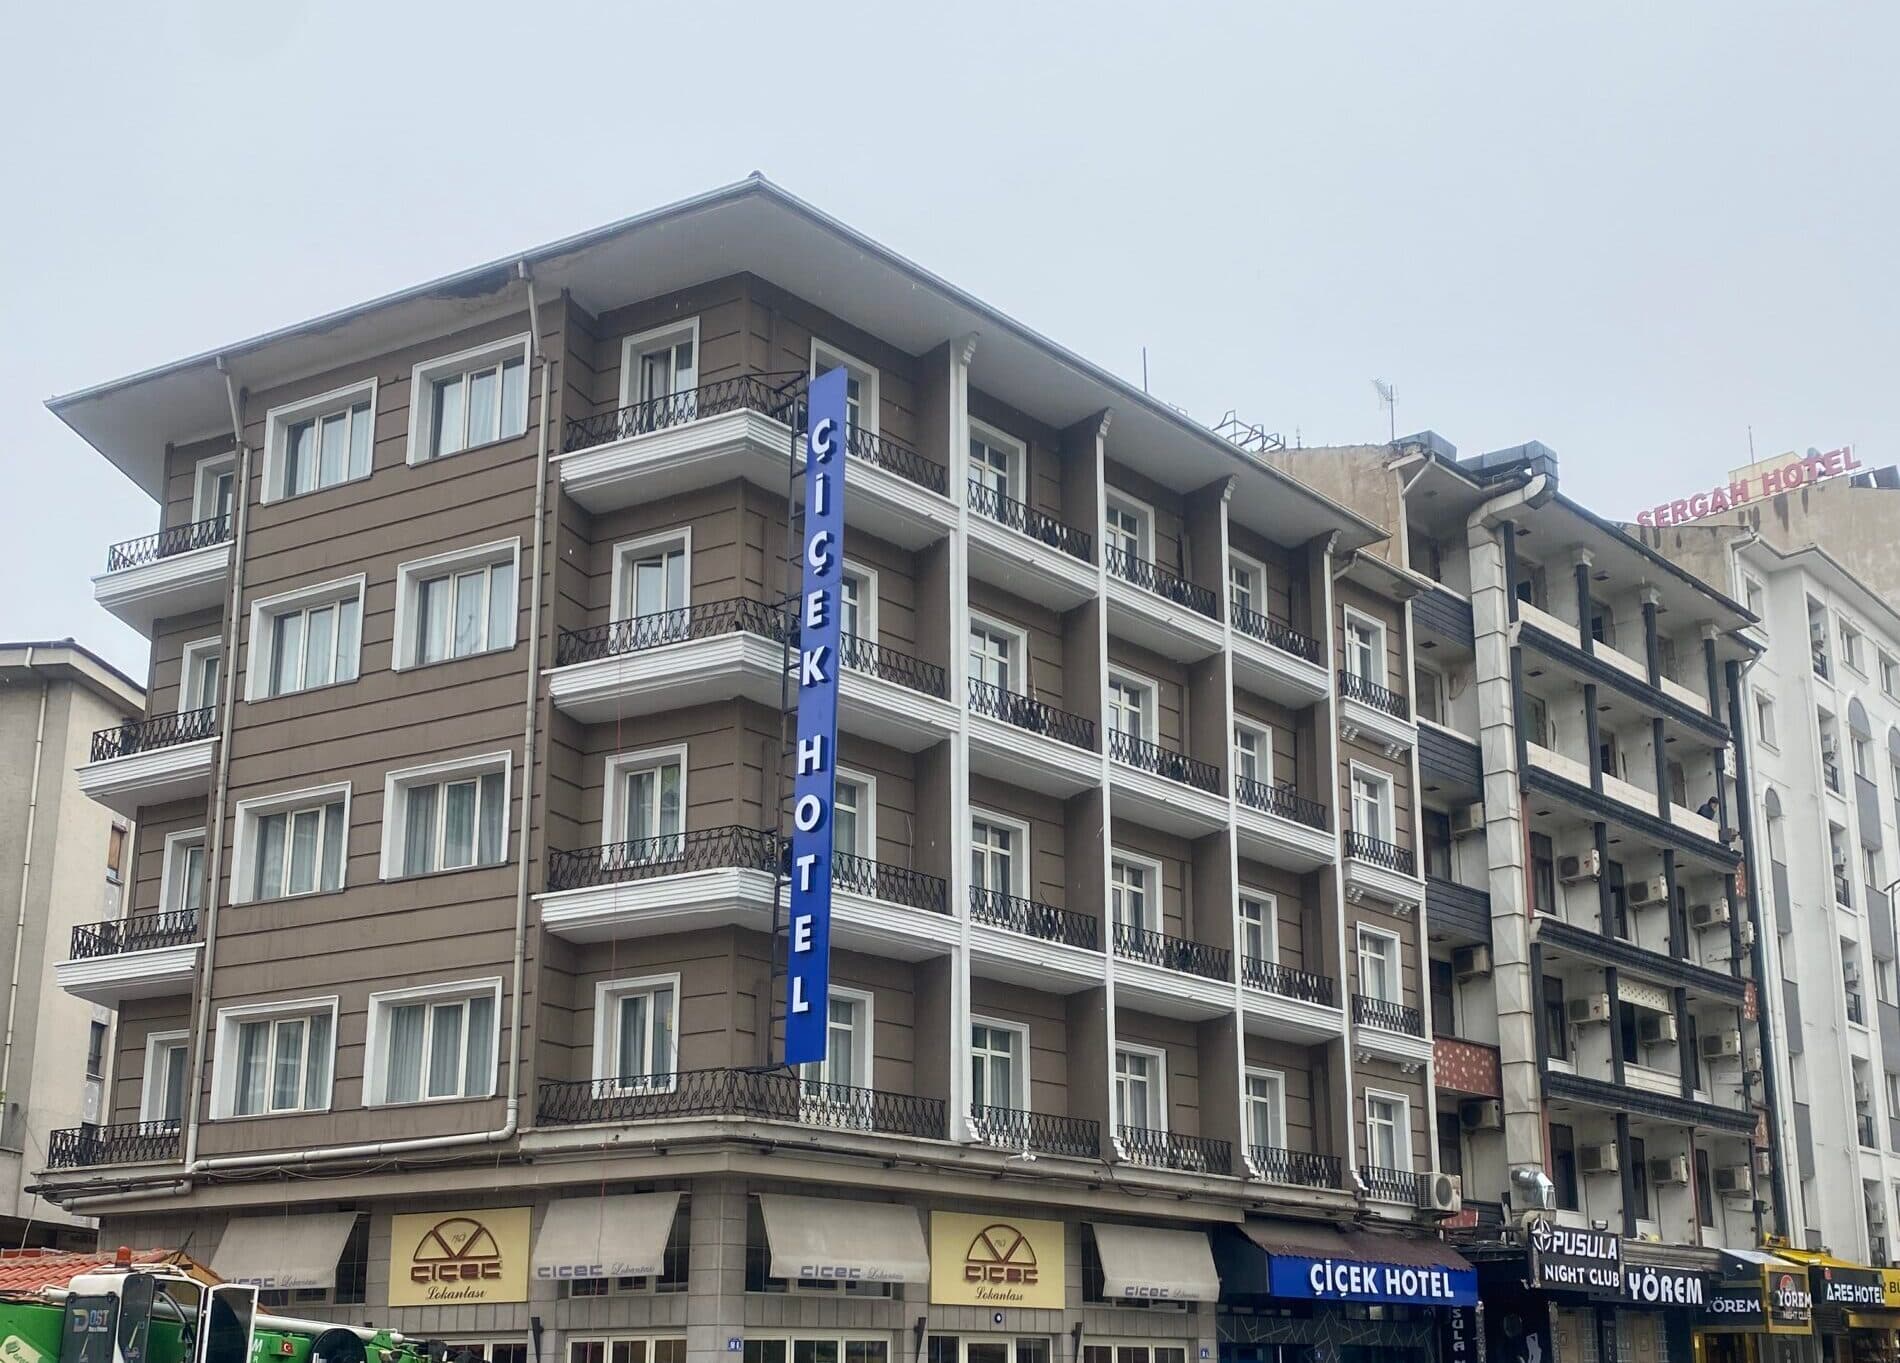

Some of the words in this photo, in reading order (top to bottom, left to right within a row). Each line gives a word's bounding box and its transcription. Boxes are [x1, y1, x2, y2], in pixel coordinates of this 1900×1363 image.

[1637, 479, 1750, 528] SERGAH
[1762, 446, 1862, 496] HOTEL
[802, 417, 837, 687] ÇİÇEK
[791, 734, 826, 1014] HOTEL
[1552, 1231, 1618, 1260] PUSULA
[427, 1285, 487, 1300] Lokantası
[1310, 1259, 1379, 1297] ÇİÇEK
[1385, 1268, 1455, 1298] HOTEL
[1544, 1264, 1585, 1284] NIGHT
[1589, 1268, 1620, 1288] CLUB
[1628, 1267, 1703, 1304] YÖREM
[975, 1286, 1024, 1301] Lokantası
[1826, 1283, 1854, 1302] ARES
[1854, 1285, 1886, 1304] HOTEL
